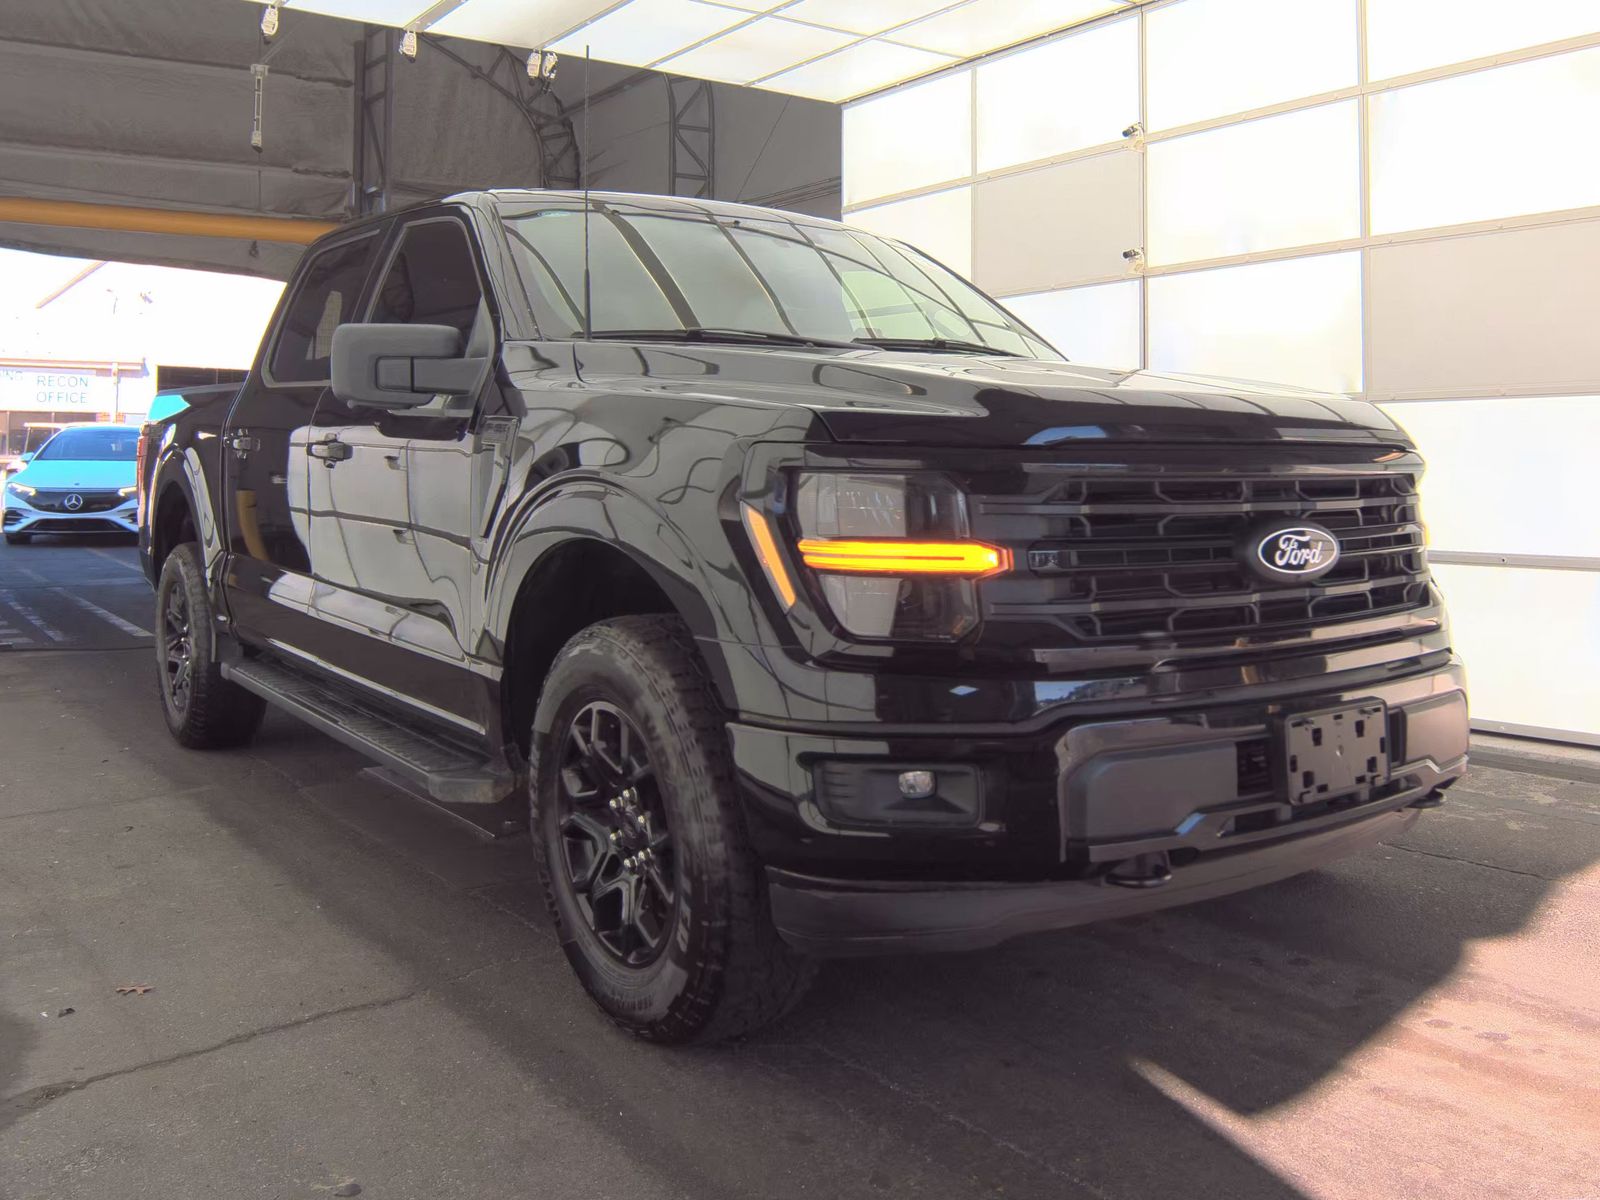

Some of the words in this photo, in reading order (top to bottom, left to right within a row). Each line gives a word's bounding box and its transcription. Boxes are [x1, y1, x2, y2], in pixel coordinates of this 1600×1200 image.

[36, 375, 89, 388] RECON
[36, 391, 89, 404] OFFICE
[1275, 534, 1323, 567] Ford
